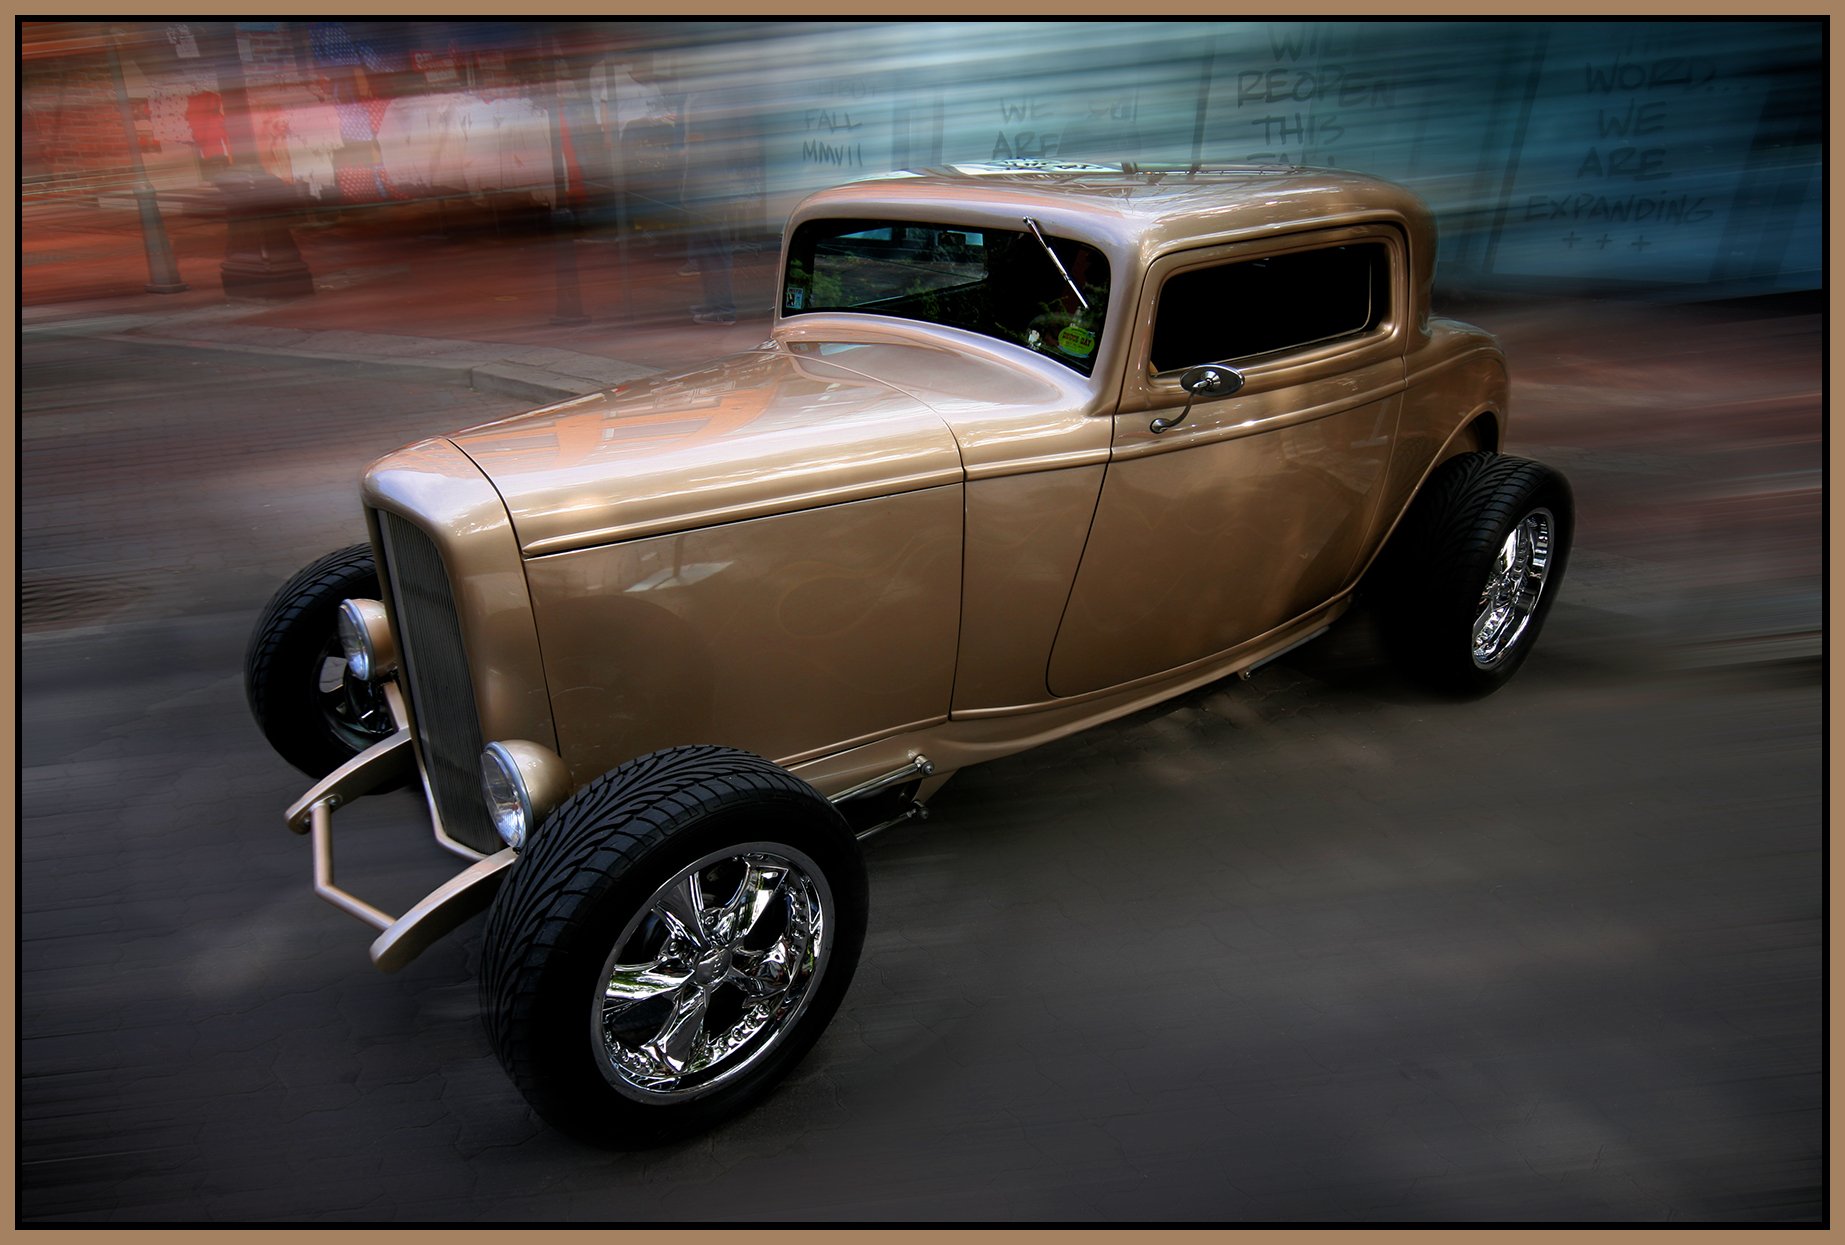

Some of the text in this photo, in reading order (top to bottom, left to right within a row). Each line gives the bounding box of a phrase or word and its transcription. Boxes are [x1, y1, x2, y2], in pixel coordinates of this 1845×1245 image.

[1237, 64, 1397, 110] REOPEN
[803, 108, 863, 132] FALL
[1252, 112, 1345, 147] THIS
[1597, 98, 1667, 139] WE
[803, 138, 864, 168] MMVII
[1577, 146, 1672, 182] ARE
[1524, 190, 1715, 227] EXPANDING
